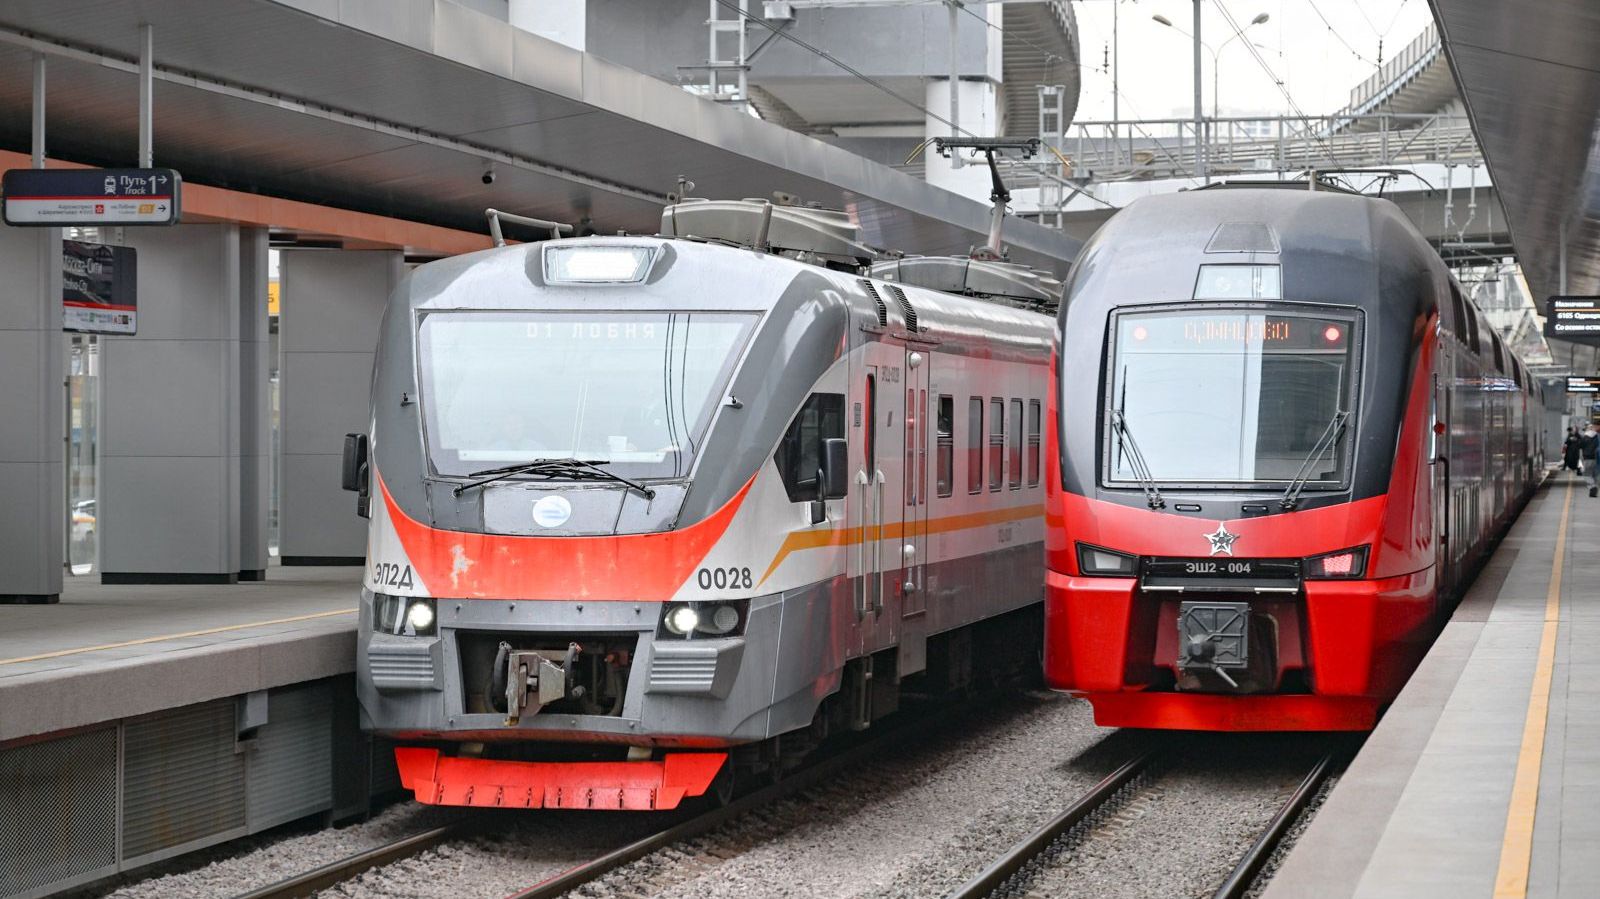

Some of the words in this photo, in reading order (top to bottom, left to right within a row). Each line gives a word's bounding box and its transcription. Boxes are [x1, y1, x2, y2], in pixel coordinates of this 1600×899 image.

[120, 175, 147, 186] Путь
[148, 175, 156, 194] 1
[124, 187, 146, 195] Track
[572, 322, 655, 338] ЛОБНЯ
[373, 563, 414, 590] ЭП2Д
[1185, 563, 1216, 573] ЭШ2
[1228, 563, 1250, 573] 004
[698, 567, 752, 590] 0028
